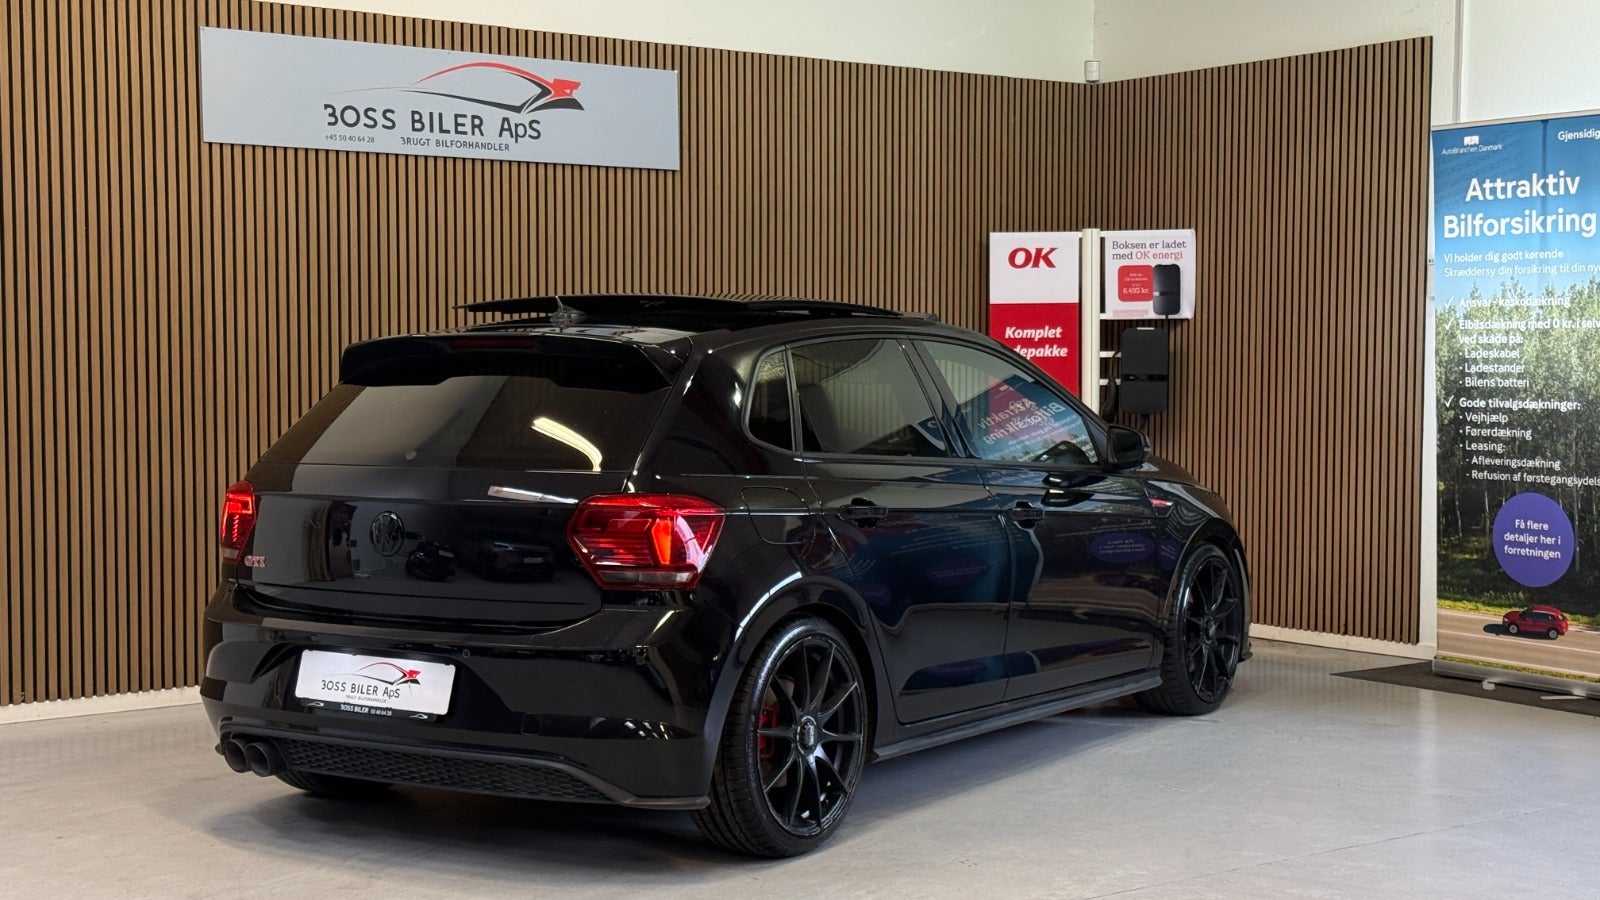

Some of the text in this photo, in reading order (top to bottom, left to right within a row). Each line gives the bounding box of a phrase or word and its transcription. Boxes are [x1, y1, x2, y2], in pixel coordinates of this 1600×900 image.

[410, 110, 484, 137] BILER
[498, 116, 542, 144] ApS
[435, 138, 510, 152] BILFORHANDLER
[1478, 144, 1503, 152] Danmark
[1464, 170, 1581, 202] Attraktiv
[1443, 207, 1597, 239] Bilforsikring
[1112, 240, 1146, 250] Boksen
[1162, 240, 1187, 249] ladet
[1007, 247, 1059, 269] OK
[1112, 250, 1183, 261] med OK energi
[1444, 248, 1564, 264] Vi holder dig godt kørende
[1444, 266, 1495, 278] Skræddersy
[1498, 266, 1512, 276] din
[1514, 264, 1557, 277] forsikring
[1558, 263, 1571, 273] til
[1572, 262, 1586, 272] din
[1528, 318, 1550, 330] med
[1553, 318, 1559, 328] 0
[1562, 318, 1574, 329] kr.
[1004, 324, 1062, 342] Komplet
[1458, 334, 1478, 344] ved
[1478, 334, 1508, 344] skade
[1464, 348, 1520, 360] Ladeskabel
[1464, 363, 1526, 374] Ladestander
[1464, 377, 1530, 388] Bilens batteri
[1459, 398, 1582, 413] Gode tilvalgsdækninger:
[1465, 412, 1509, 425] Vejhjælp
[1465, 427, 1532, 440] Førerdækning
[1465, 441, 1506, 454] Leasing:
[1471, 456, 1560, 471] Afleveringsdækning
[1471, 470, 1512, 482] Refusion
[1512, 471, 1522, 482] af
[1514, 518, 1550, 531] Få flere
[1504, 531, 1561, 546] detaljer her i
[1504, 544, 1562, 560] forretningen
[243, 554, 266, 568] GTI
[350, 683, 378, 697] BILER
[382, 686, 401, 700] ApS
[354, 704, 369, 714] BILER
